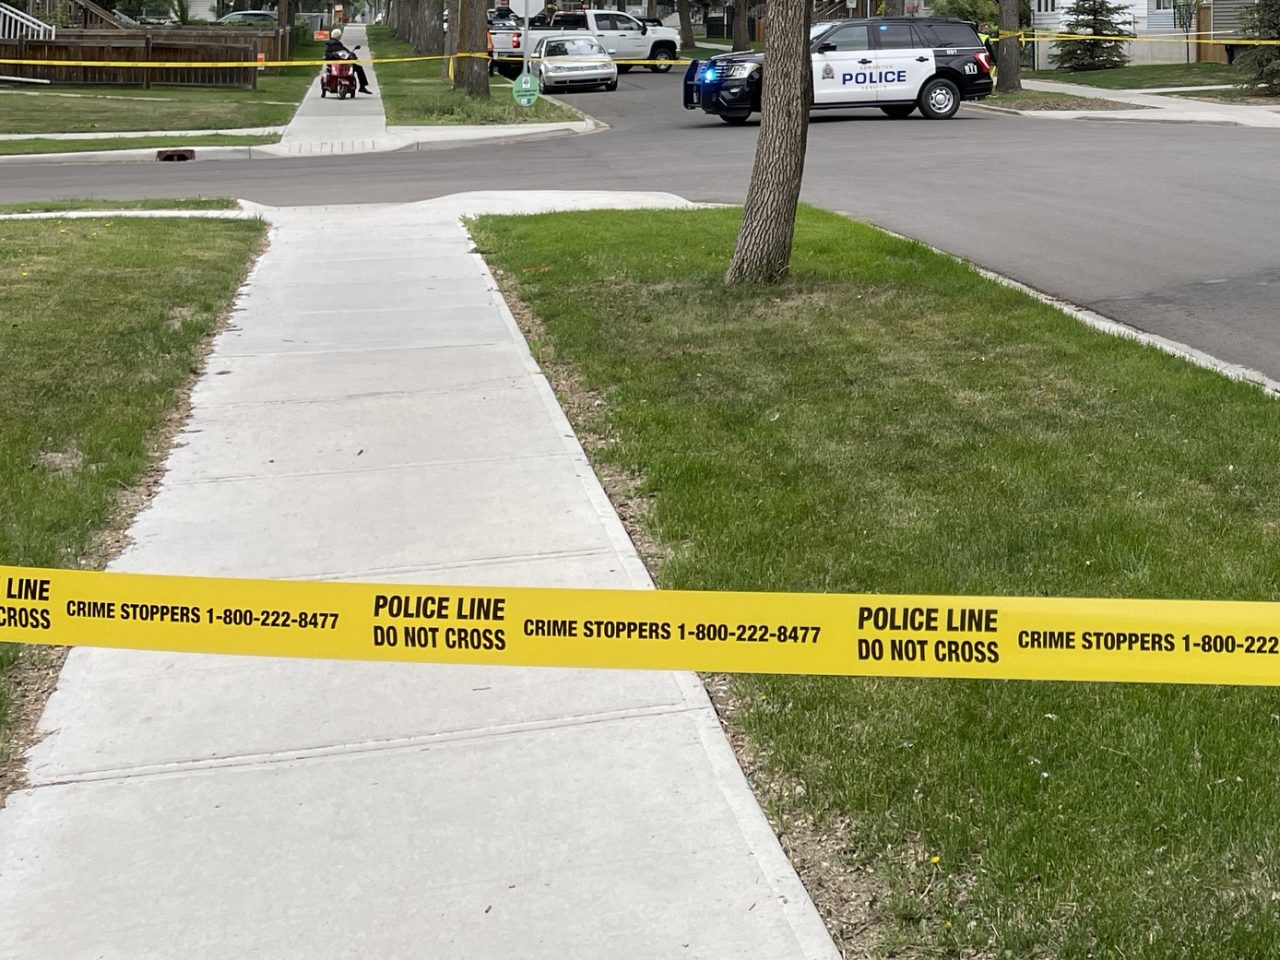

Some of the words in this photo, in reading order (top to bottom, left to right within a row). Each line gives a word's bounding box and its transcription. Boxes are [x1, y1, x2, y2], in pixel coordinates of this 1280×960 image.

[842, 70, 907, 85] POLICE
[7, 578, 51, 601] LINE
[66, 600, 116, 619] CRIME
[120, 604, 201, 623] STOPPERS
[206, 608, 339, 630] 1-800-222-8477
[373, 596, 450, 620] POLICE
[456, 598, 506, 622] LINE
[858, 607, 939, 632] POLICE
[946, 609, 998, 633] LINE
[373, 626, 398, 647] DO
[403, 627, 439, 649] NOT
[445, 627, 506, 651] CROSS
[523, 619, 578, 638] CRIME
[583, 620, 671, 640] STOPPERS
[677, 623, 821, 644] 1-800-222-8477
[1018, 631, 1076, 650] CRIME
[1081, 632, 1175, 653] STOPPERS
[857, 639, 884, 661] DO
[890, 639, 929, 662] NOT
[934, 640, 1000, 664] CROSS
